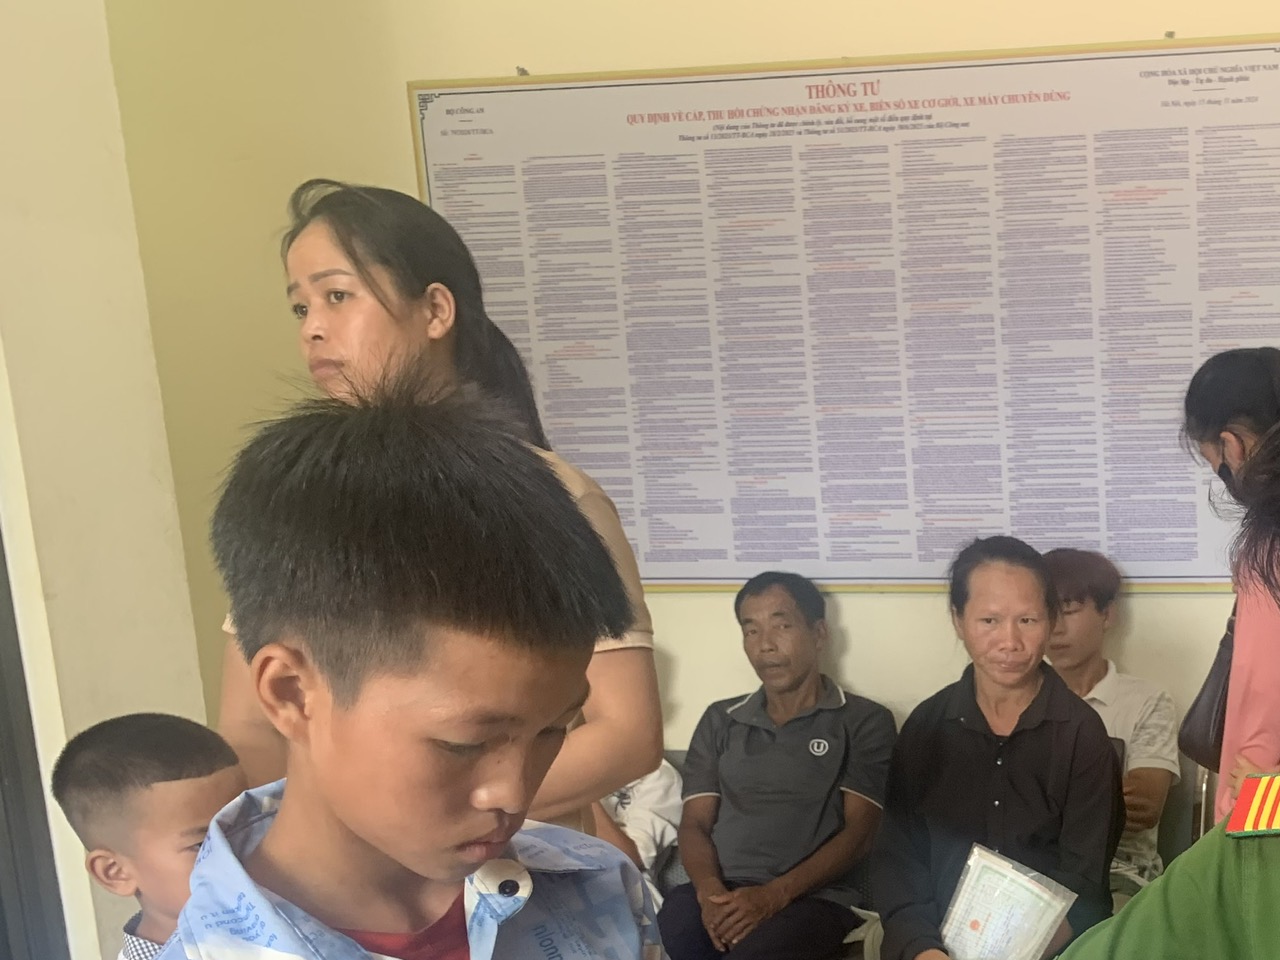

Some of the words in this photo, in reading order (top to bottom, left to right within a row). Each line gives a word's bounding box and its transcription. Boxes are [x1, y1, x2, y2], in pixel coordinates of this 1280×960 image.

[806, 80, 857, 100] THÔNG
[861, 79, 881, 97] TƯ
[627, 113, 645, 126] QUY
